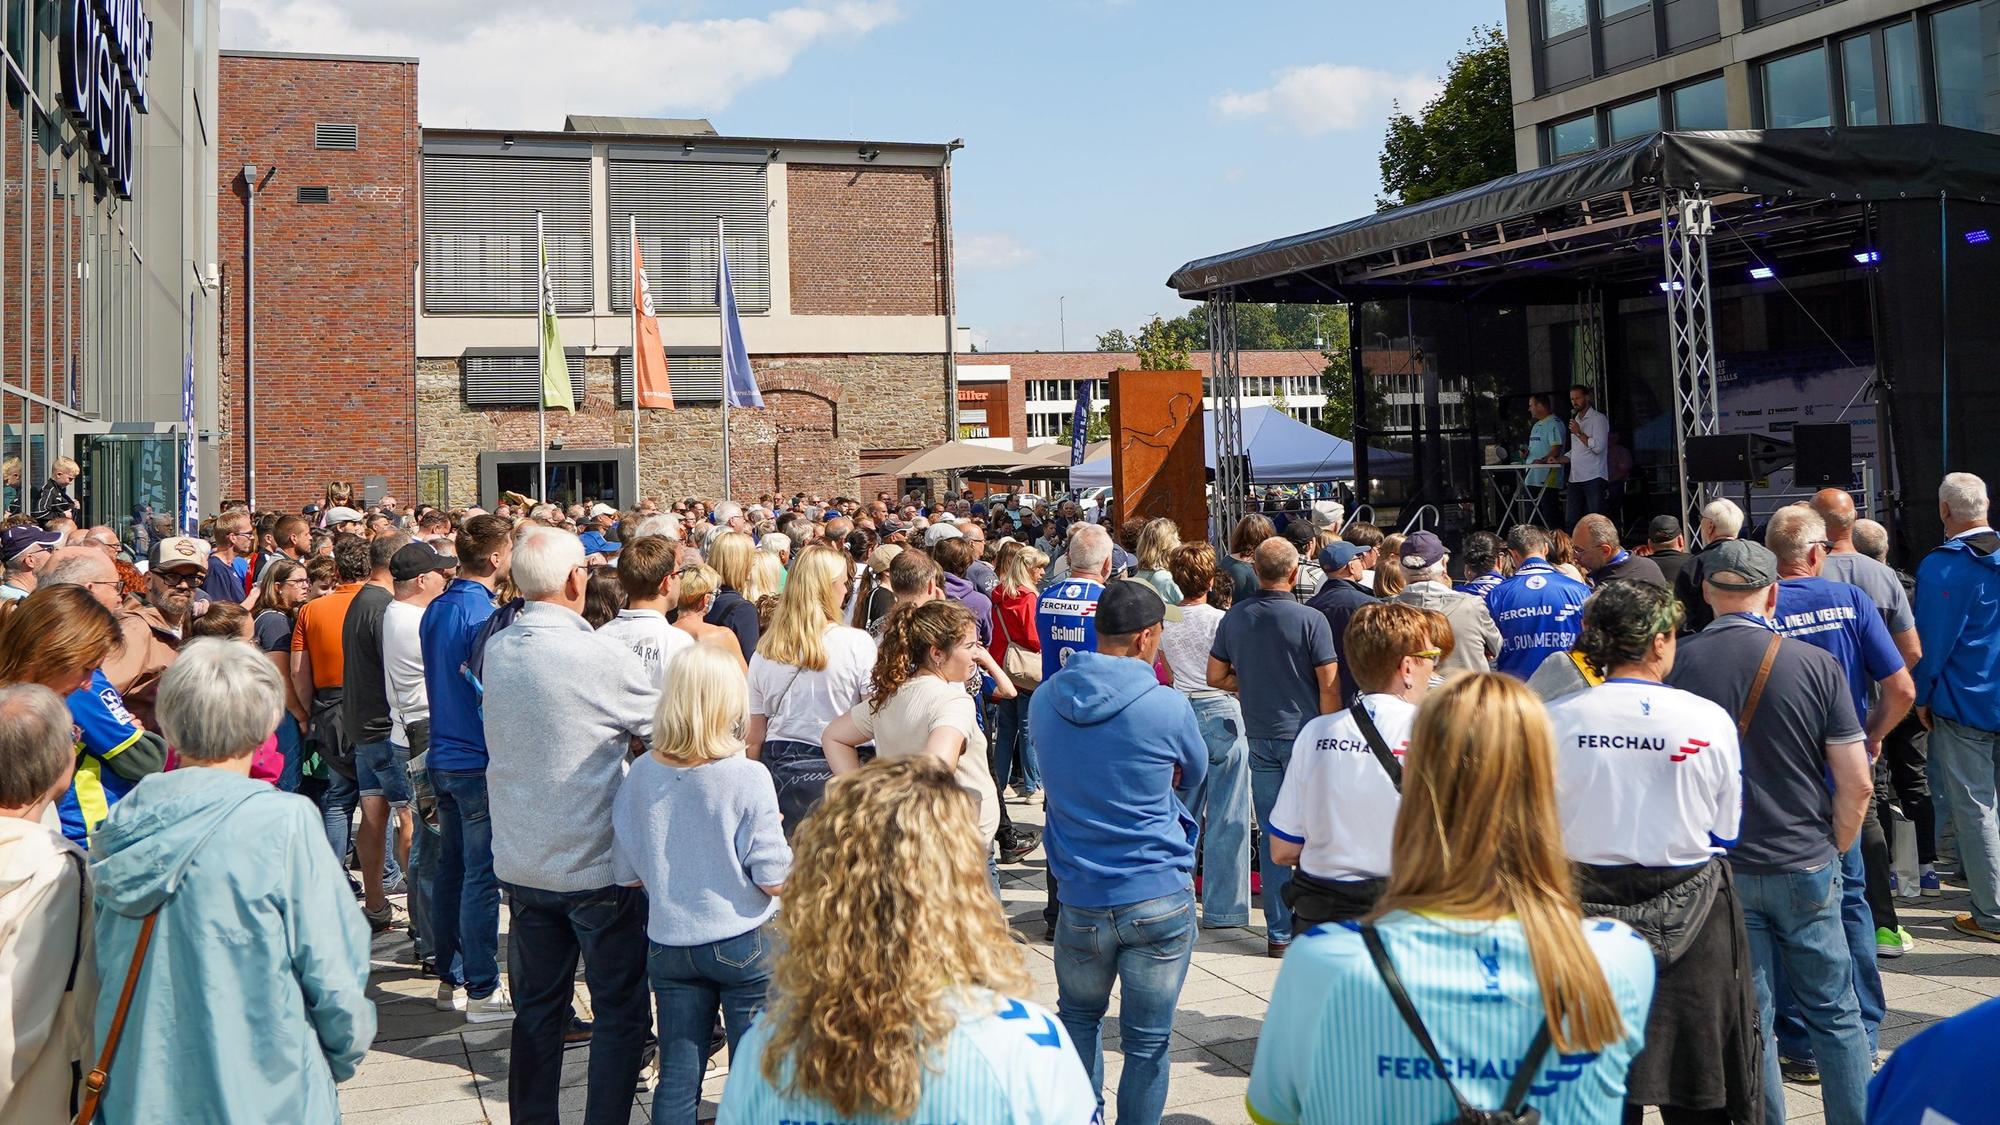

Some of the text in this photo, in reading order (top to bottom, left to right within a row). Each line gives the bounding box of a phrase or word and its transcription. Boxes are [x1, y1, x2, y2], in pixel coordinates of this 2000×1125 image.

[957, 389, 989, 401] üller
[1040, 601, 1079, 611] FERCHAU
[1499, 605, 1552, 622] FERCHAU
[1785, 611, 1816, 628] MEIN
[1051, 625, 1085, 642] Scholli
[1514, 632, 1576, 650] GUMMERSBA
[1315, 738, 1371, 754] FERCHA
[1578, 735, 1665, 751] FERCHAU
[1378, 1055, 1521, 1081] FERCHAU
